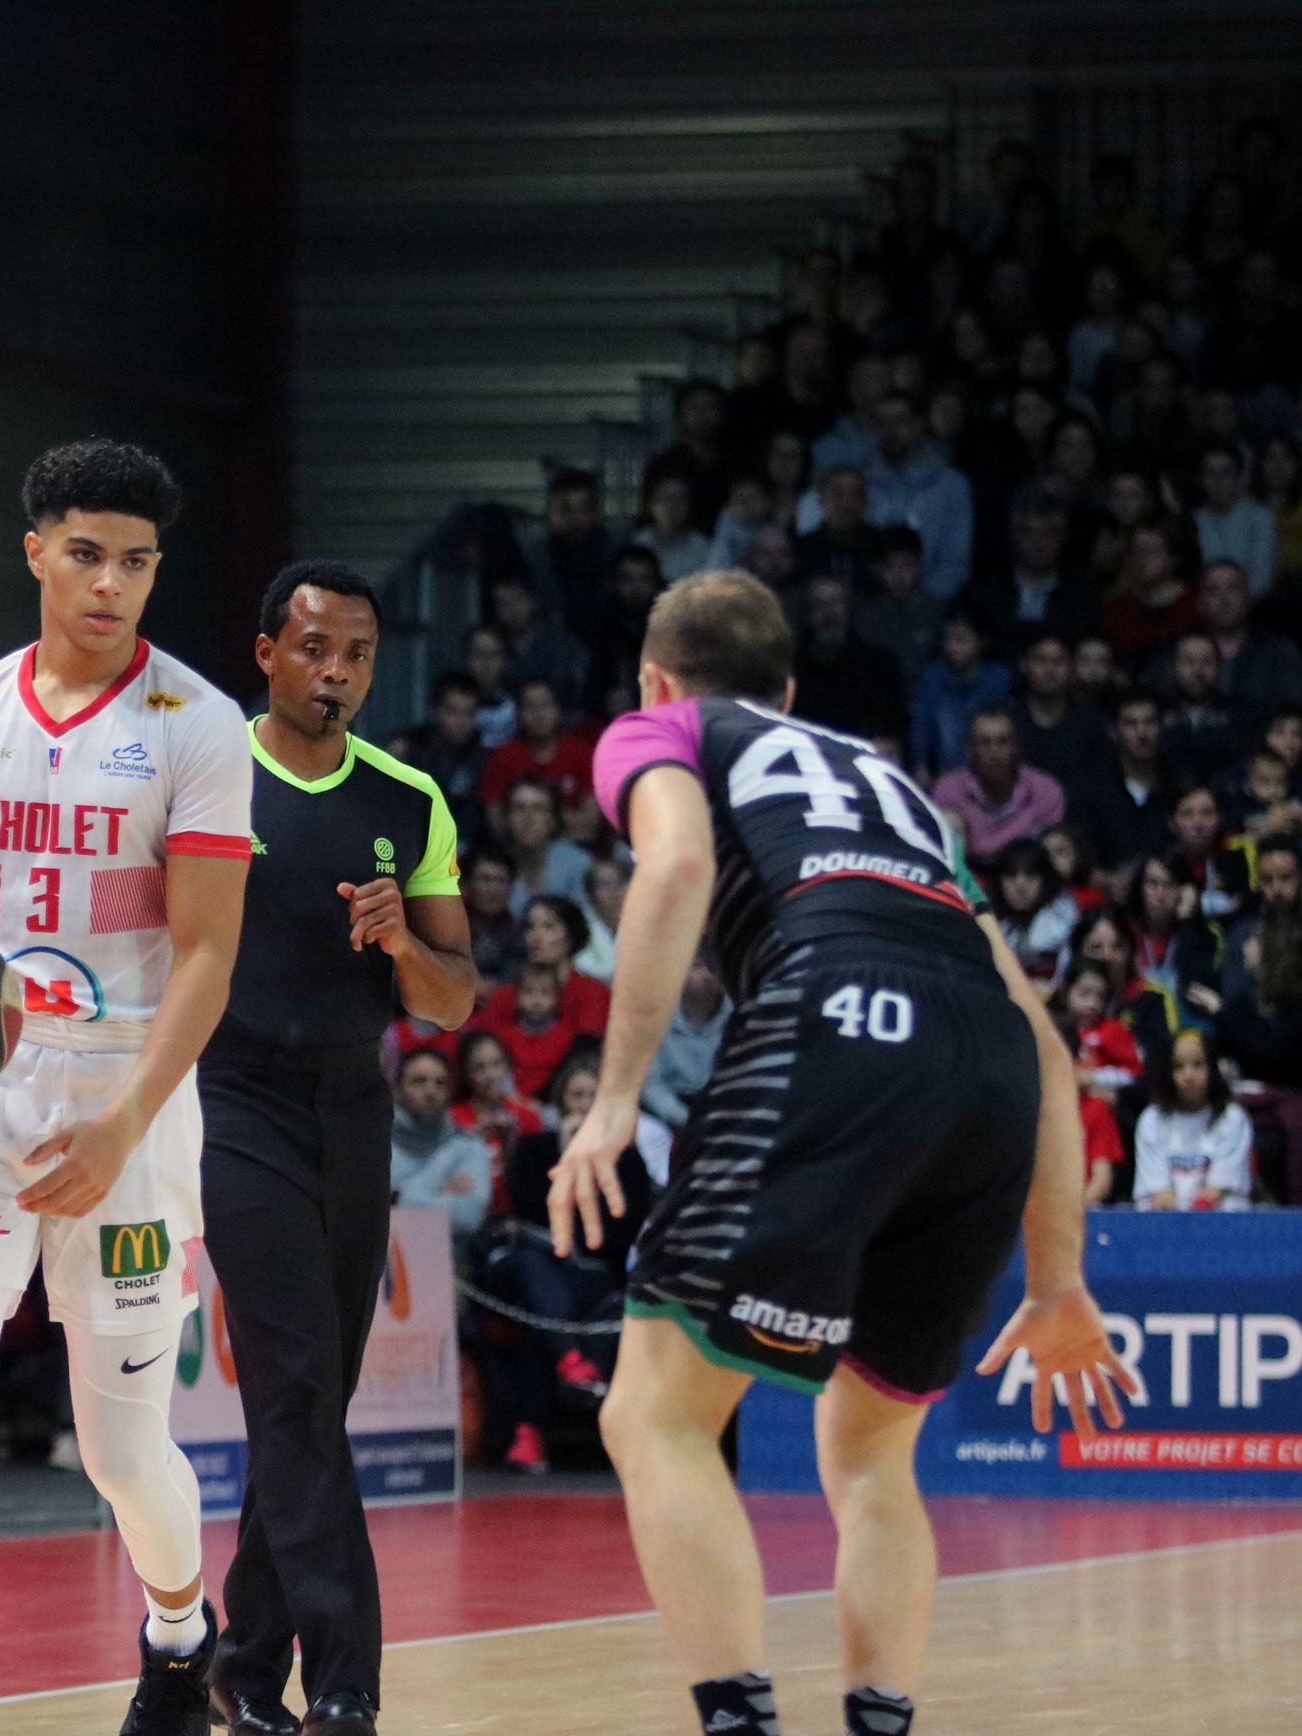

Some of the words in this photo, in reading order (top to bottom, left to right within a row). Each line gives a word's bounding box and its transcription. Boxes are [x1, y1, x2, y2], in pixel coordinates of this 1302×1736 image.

[99, 761, 111, 770] Le
[728, 726, 956, 873] 40
[376, 861, 396, 874] FFBB
[25, 868, 61, 933] 3
[822, 985, 913, 1043] 40
[114, 1274, 161, 1290] CHOLET
[115, 1293, 161, 1310] SPALDING
[1079, 1437, 1151, 1462] VOTRE
[1157, 1437, 1237, 1467] PROJET
[1242, 1438, 1271, 1463] SE
